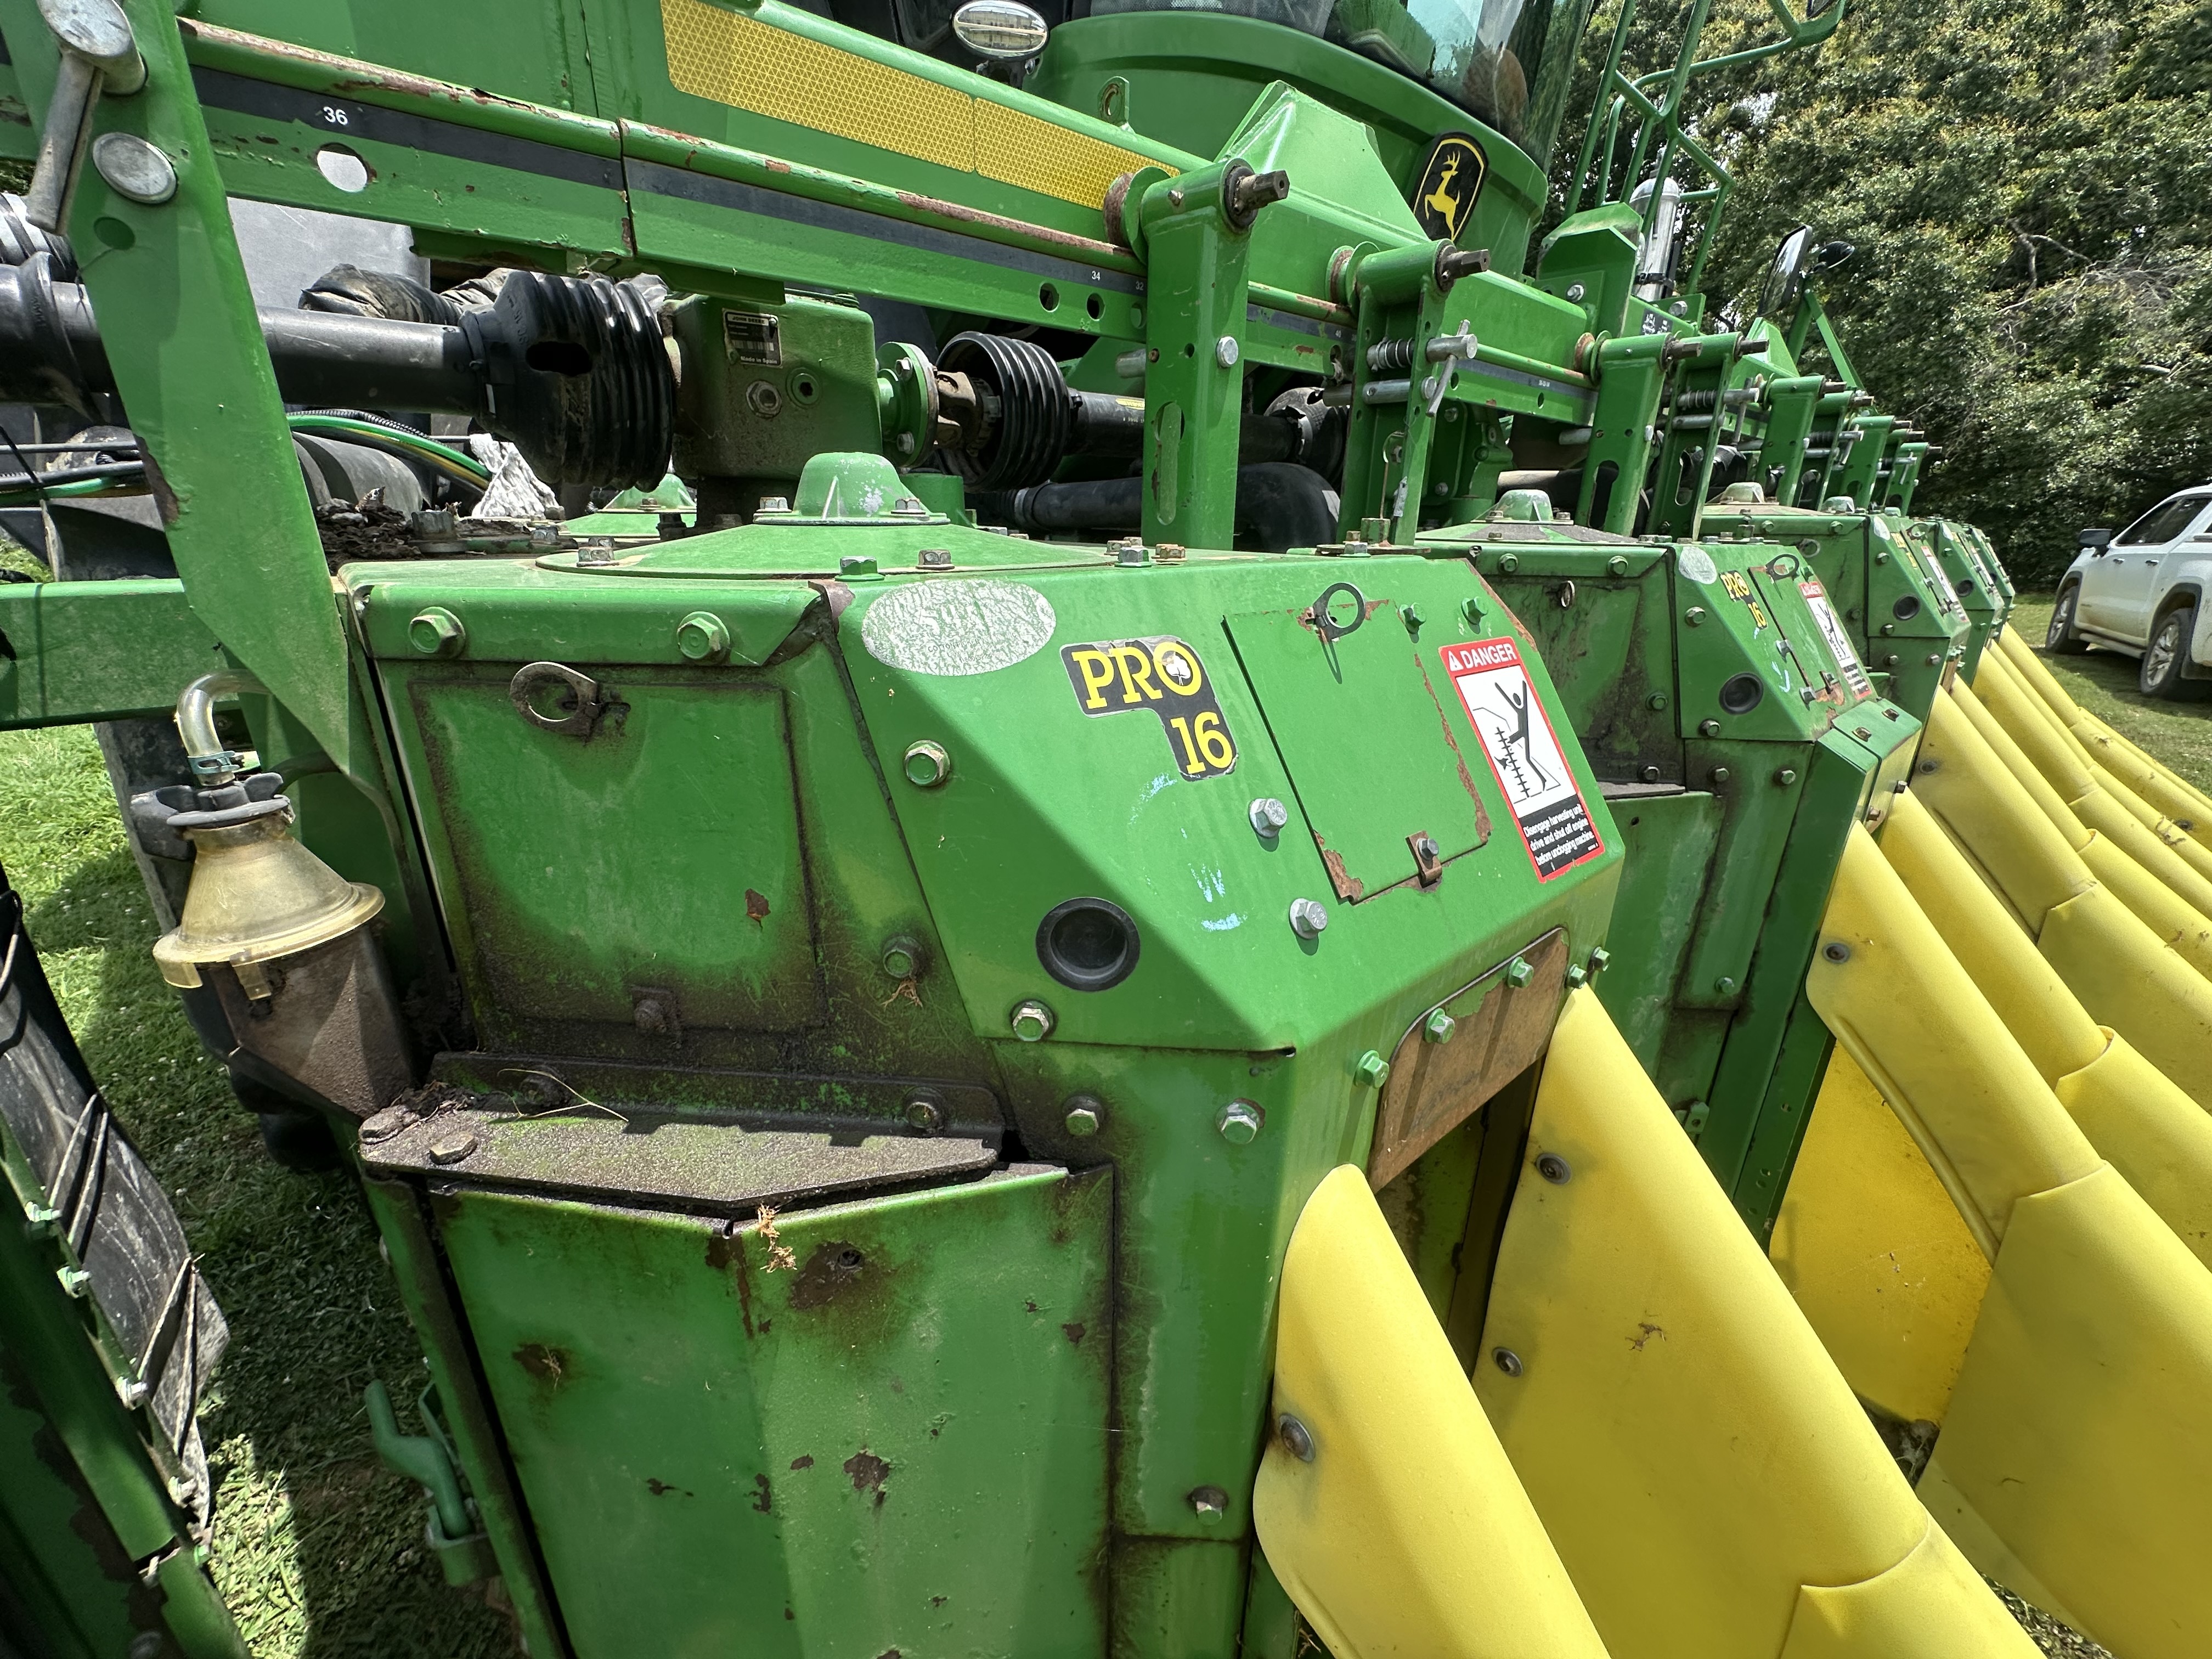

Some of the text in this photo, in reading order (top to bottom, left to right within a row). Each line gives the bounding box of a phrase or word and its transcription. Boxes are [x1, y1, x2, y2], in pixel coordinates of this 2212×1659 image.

[323, 106, 348, 125] 36
[1092, 270, 1101, 281] 34
[1136, 281, 1144, 291] 32
[1720, 572, 1751, 599] PRO
[1748, 601, 1767, 628] 16
[1460, 643, 1517, 669] DANGER
[1071, 641, 1202, 709] PRO
[1170, 711, 1233, 775] 16
[1523, 803, 1583, 837] Disengage harvesting unit
[1530, 817, 1589, 851] drive and shut off engine
[1535, 851, 1553, 866] before
[1550, 840, 1578, 854] unclogging
